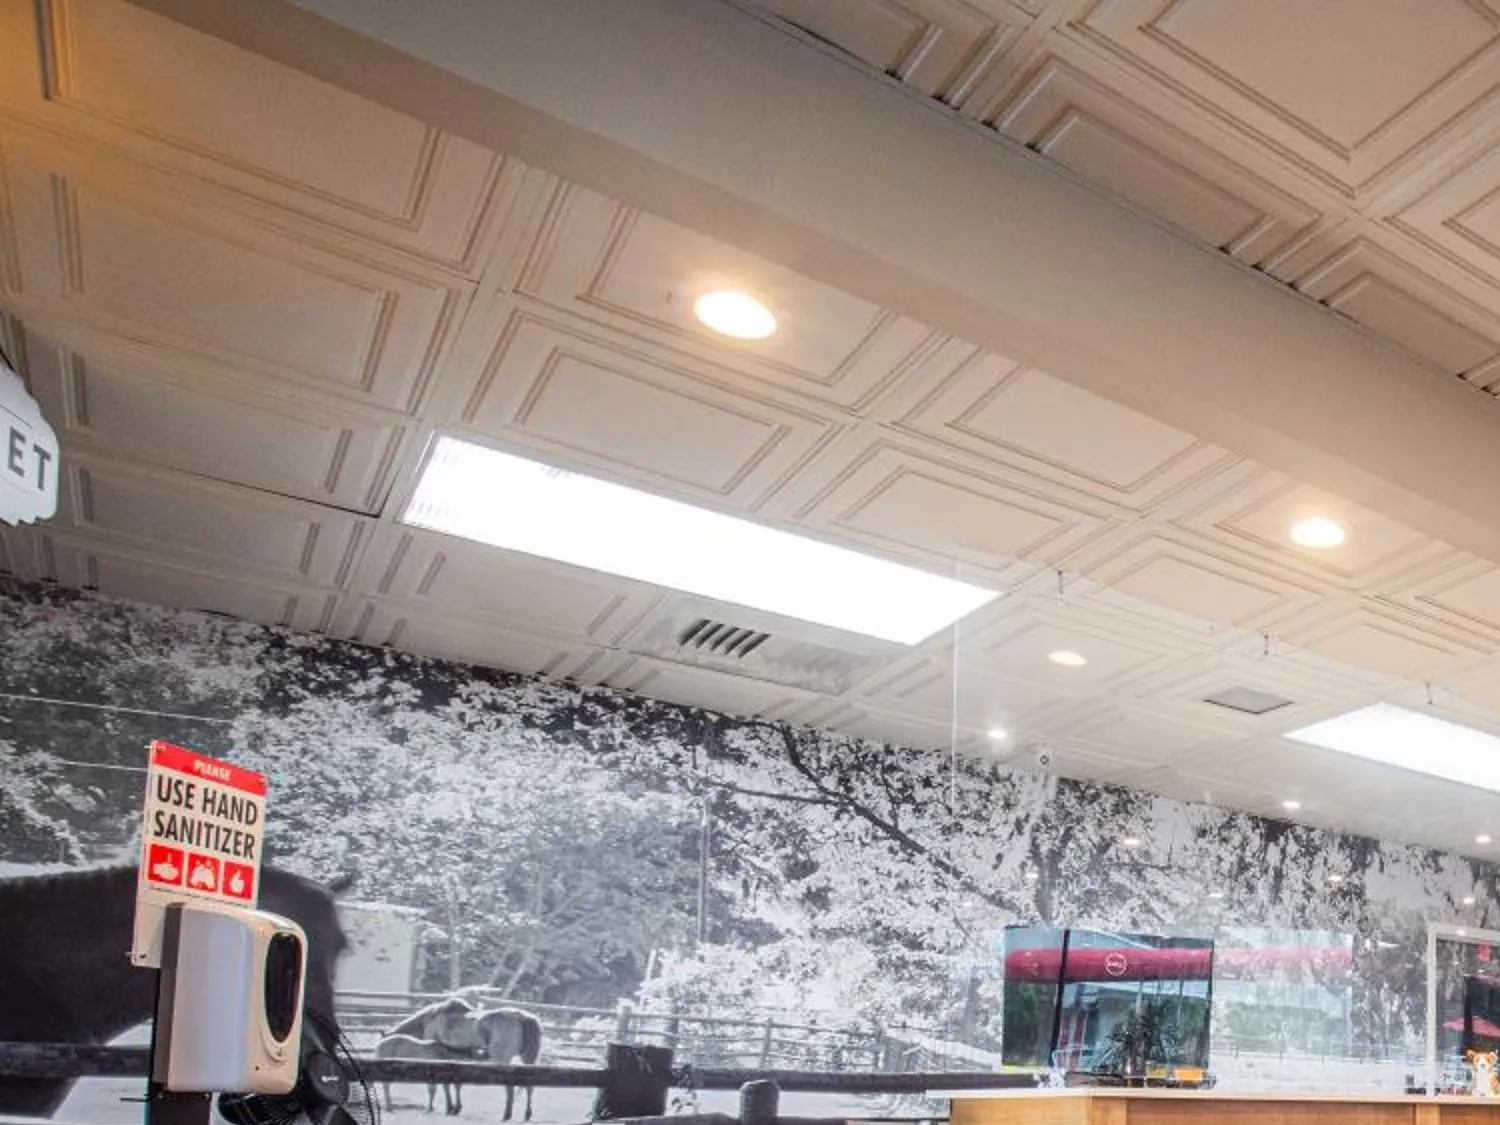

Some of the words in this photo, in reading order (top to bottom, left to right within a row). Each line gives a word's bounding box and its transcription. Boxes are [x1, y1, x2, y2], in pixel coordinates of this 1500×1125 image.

[8, 426, 51, 491] ET
[194, 759, 231, 781] PLEASE
[157, 775, 196, 810] USE
[202, 787, 258, 825] HAND
[153, 811, 255, 860] SANITIZER
